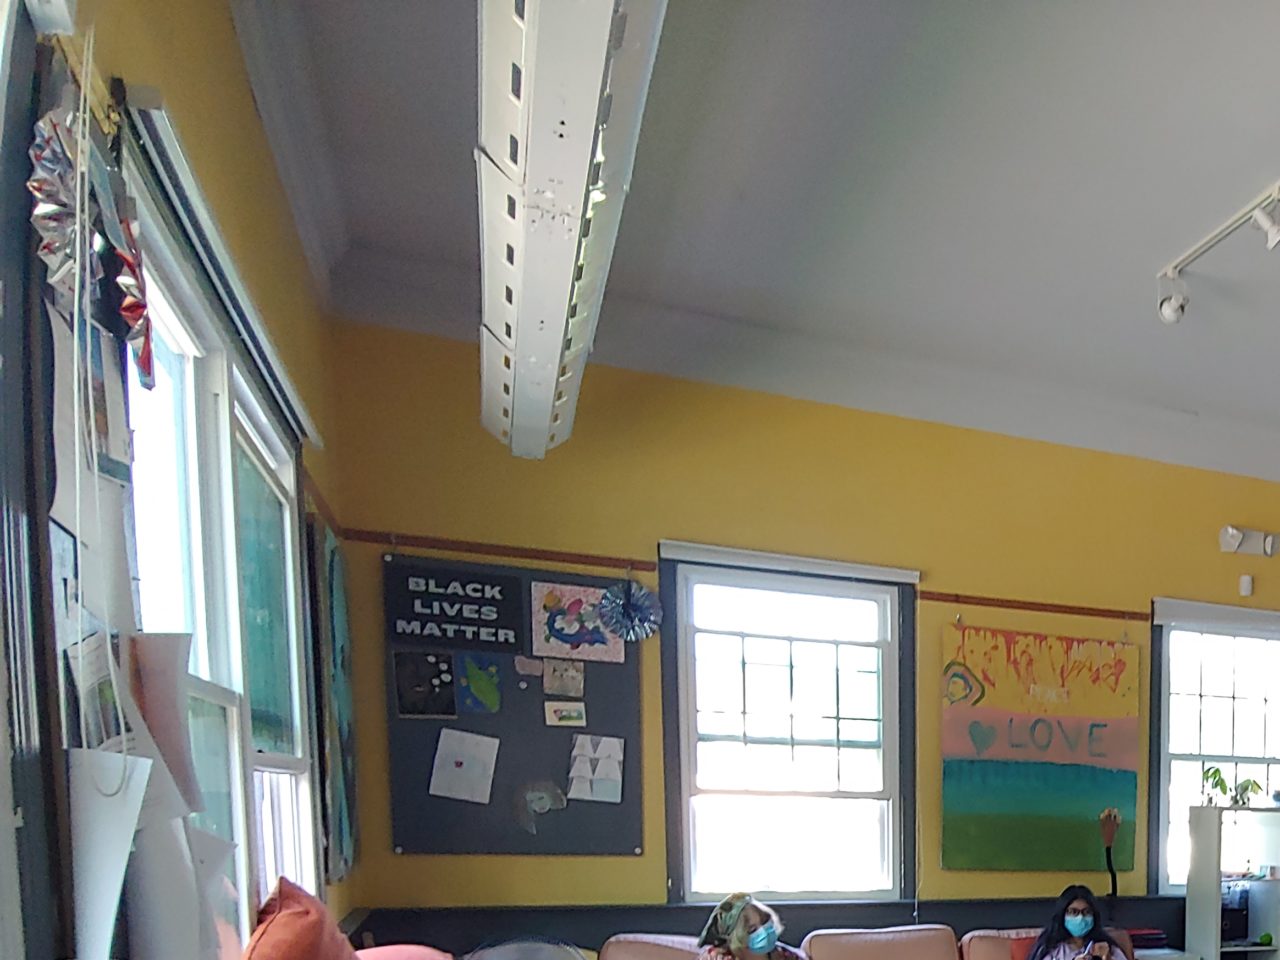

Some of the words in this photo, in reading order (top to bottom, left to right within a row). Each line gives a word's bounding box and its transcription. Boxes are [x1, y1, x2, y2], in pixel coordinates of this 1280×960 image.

[408, 576, 504, 600] BLACK
[413, 598, 499, 621] LIVES
[396, 620, 516, 644] MATTER
[1007, 717, 1109, 758] LOVE
